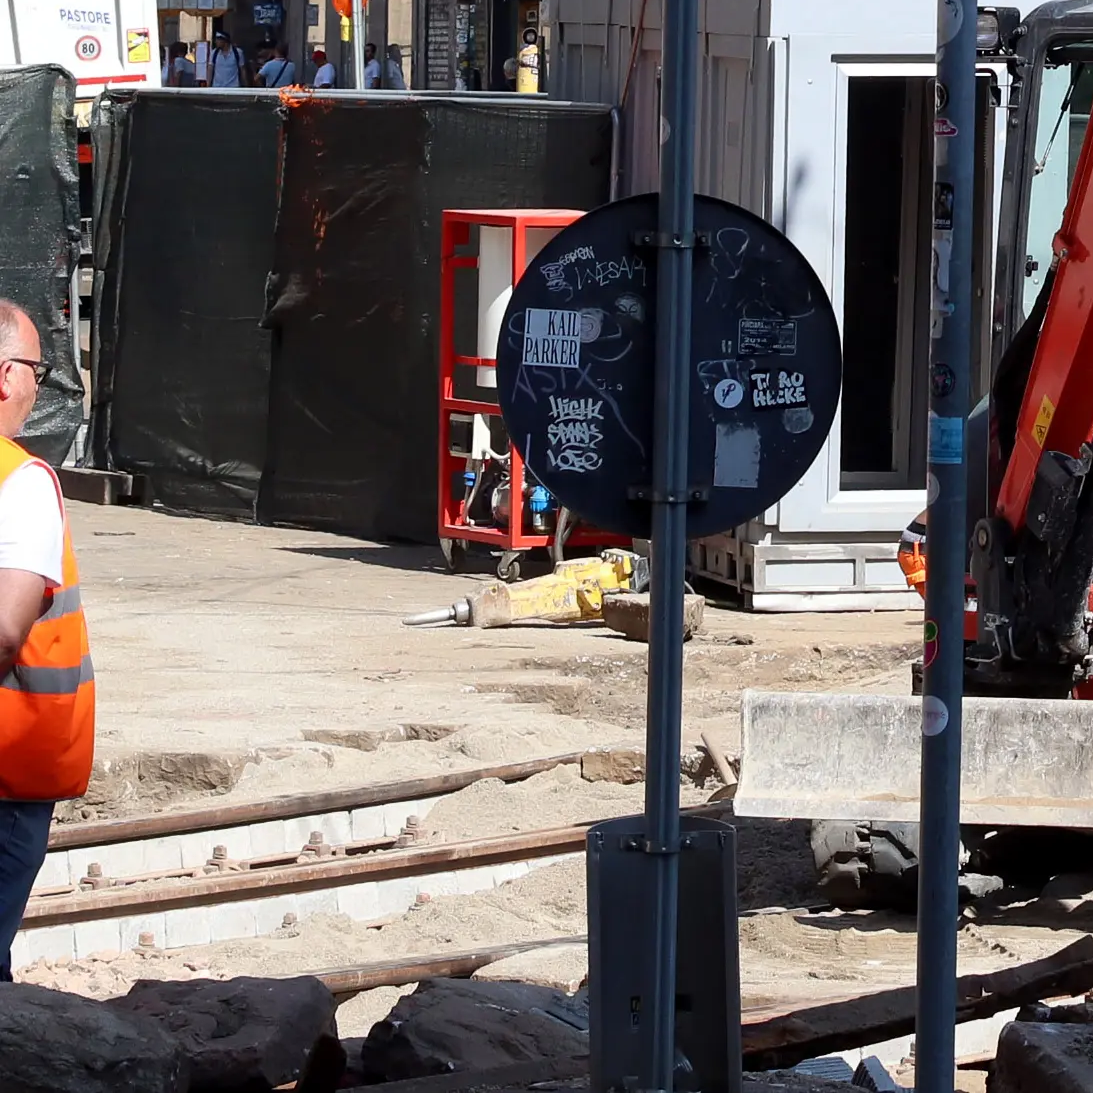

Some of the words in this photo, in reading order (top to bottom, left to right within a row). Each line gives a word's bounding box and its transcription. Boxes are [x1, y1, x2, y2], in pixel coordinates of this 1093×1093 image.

[59, 9, 111, 25] PASTORE
[82, 43, 95, 54] 80
[525, 309, 532, 334] I
[547, 310, 580, 337] KAIL
[524, 337, 578, 366] PARKER
